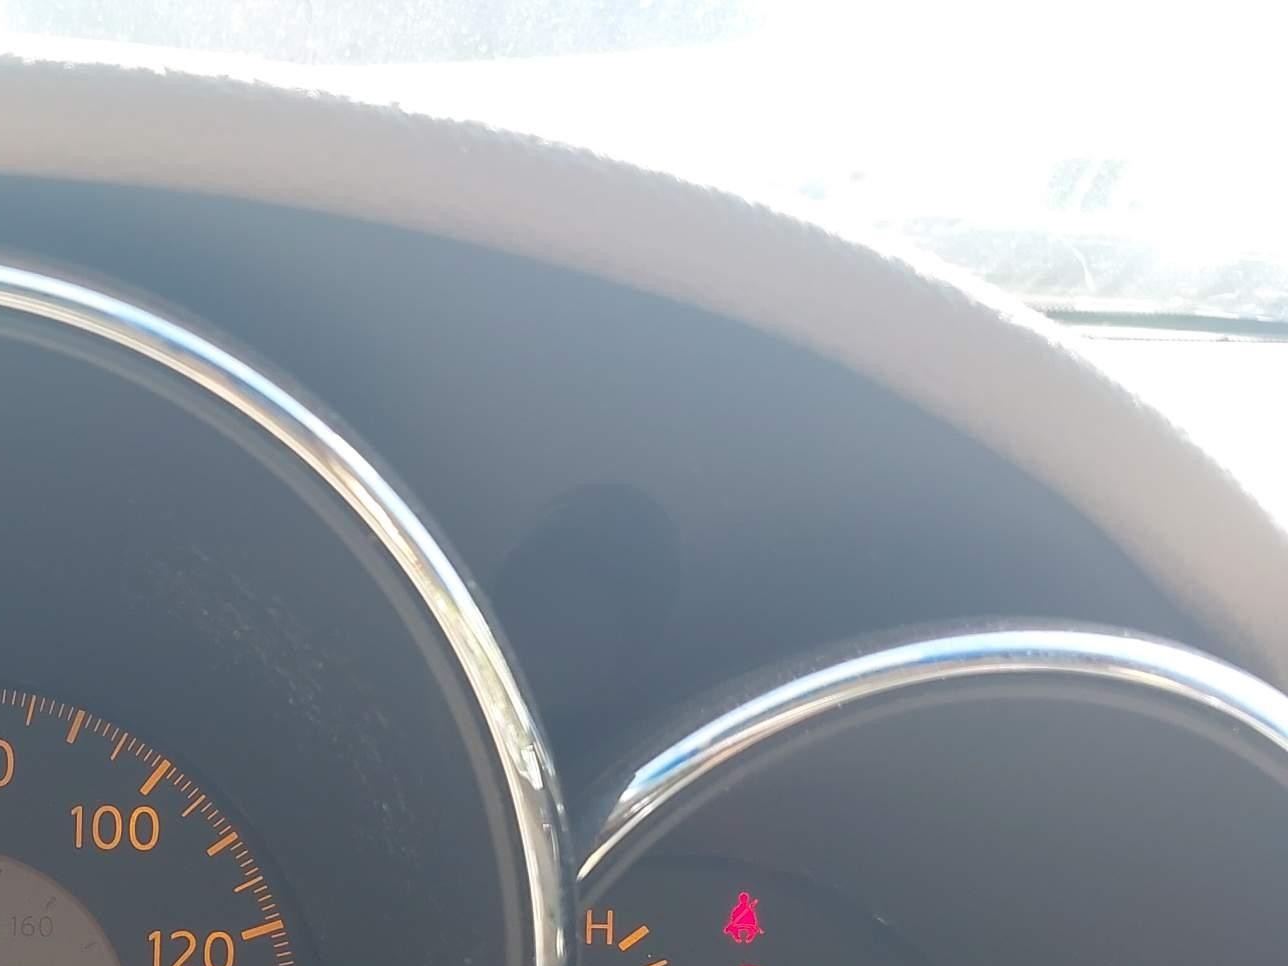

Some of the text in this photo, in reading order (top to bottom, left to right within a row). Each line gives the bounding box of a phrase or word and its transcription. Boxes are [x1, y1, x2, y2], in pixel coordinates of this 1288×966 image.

[70, 804, 161, 851] 100
[10, 914, 54, 938] 160
[585, 909, 614, 945] H
